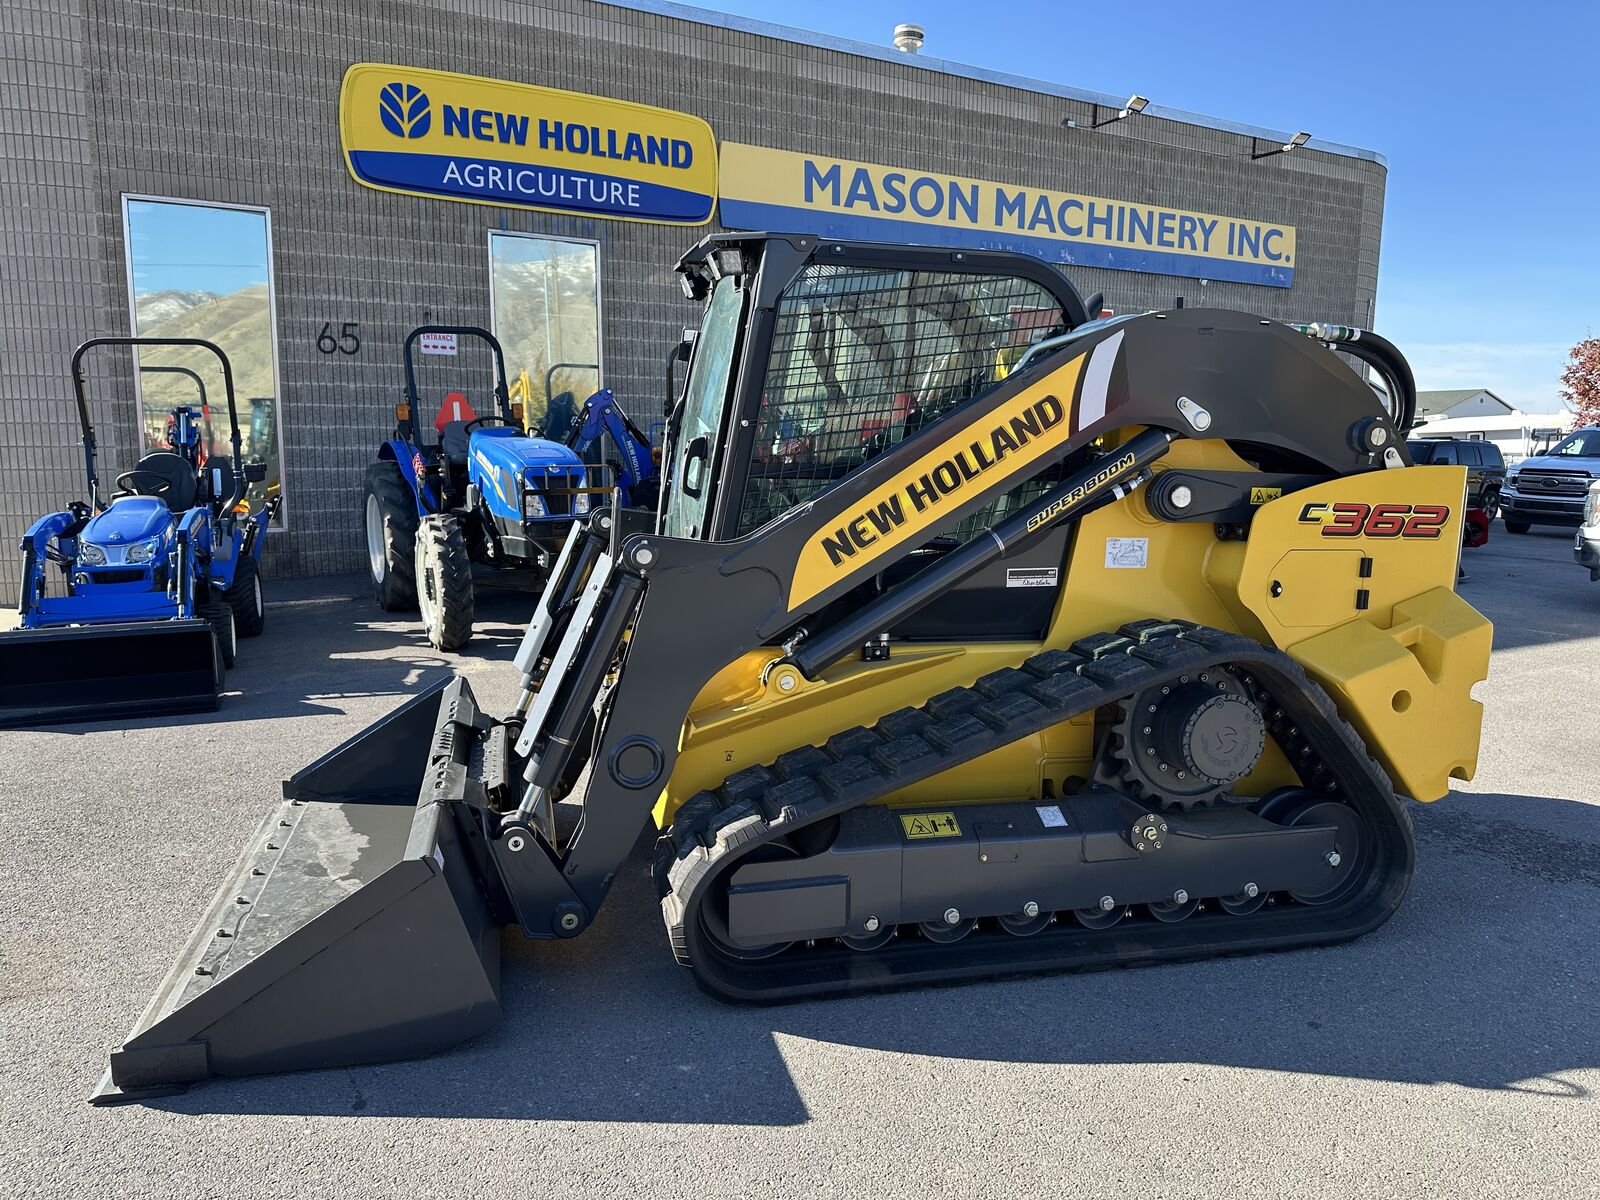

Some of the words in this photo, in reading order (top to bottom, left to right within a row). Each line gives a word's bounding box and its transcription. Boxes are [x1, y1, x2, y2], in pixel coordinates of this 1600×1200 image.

[442, 104, 529, 146] NEW
[538, 118, 694, 170] HOLLAND
[442, 161, 641, 208] AGRICULTURE
[804, 160, 980, 224] MASON
[994, 188, 1220, 252] MACHINERY
[1227, 222, 1292, 263] INC.
[317, 321, 360, 356] 65
[422, 333, 454, 342] ENTRANCE
[626, 440, 636, 456] NEW
[631, 455, 642, 485] HOLLAN
[820, 492, 906, 567] NEW
[905, 394, 1064, 513] HOLLAND
[1026, 486, 1085, 533] SUPER
[1084, 452, 1136, 494] BOOM
[1297, 502, 1451, 540] C362
